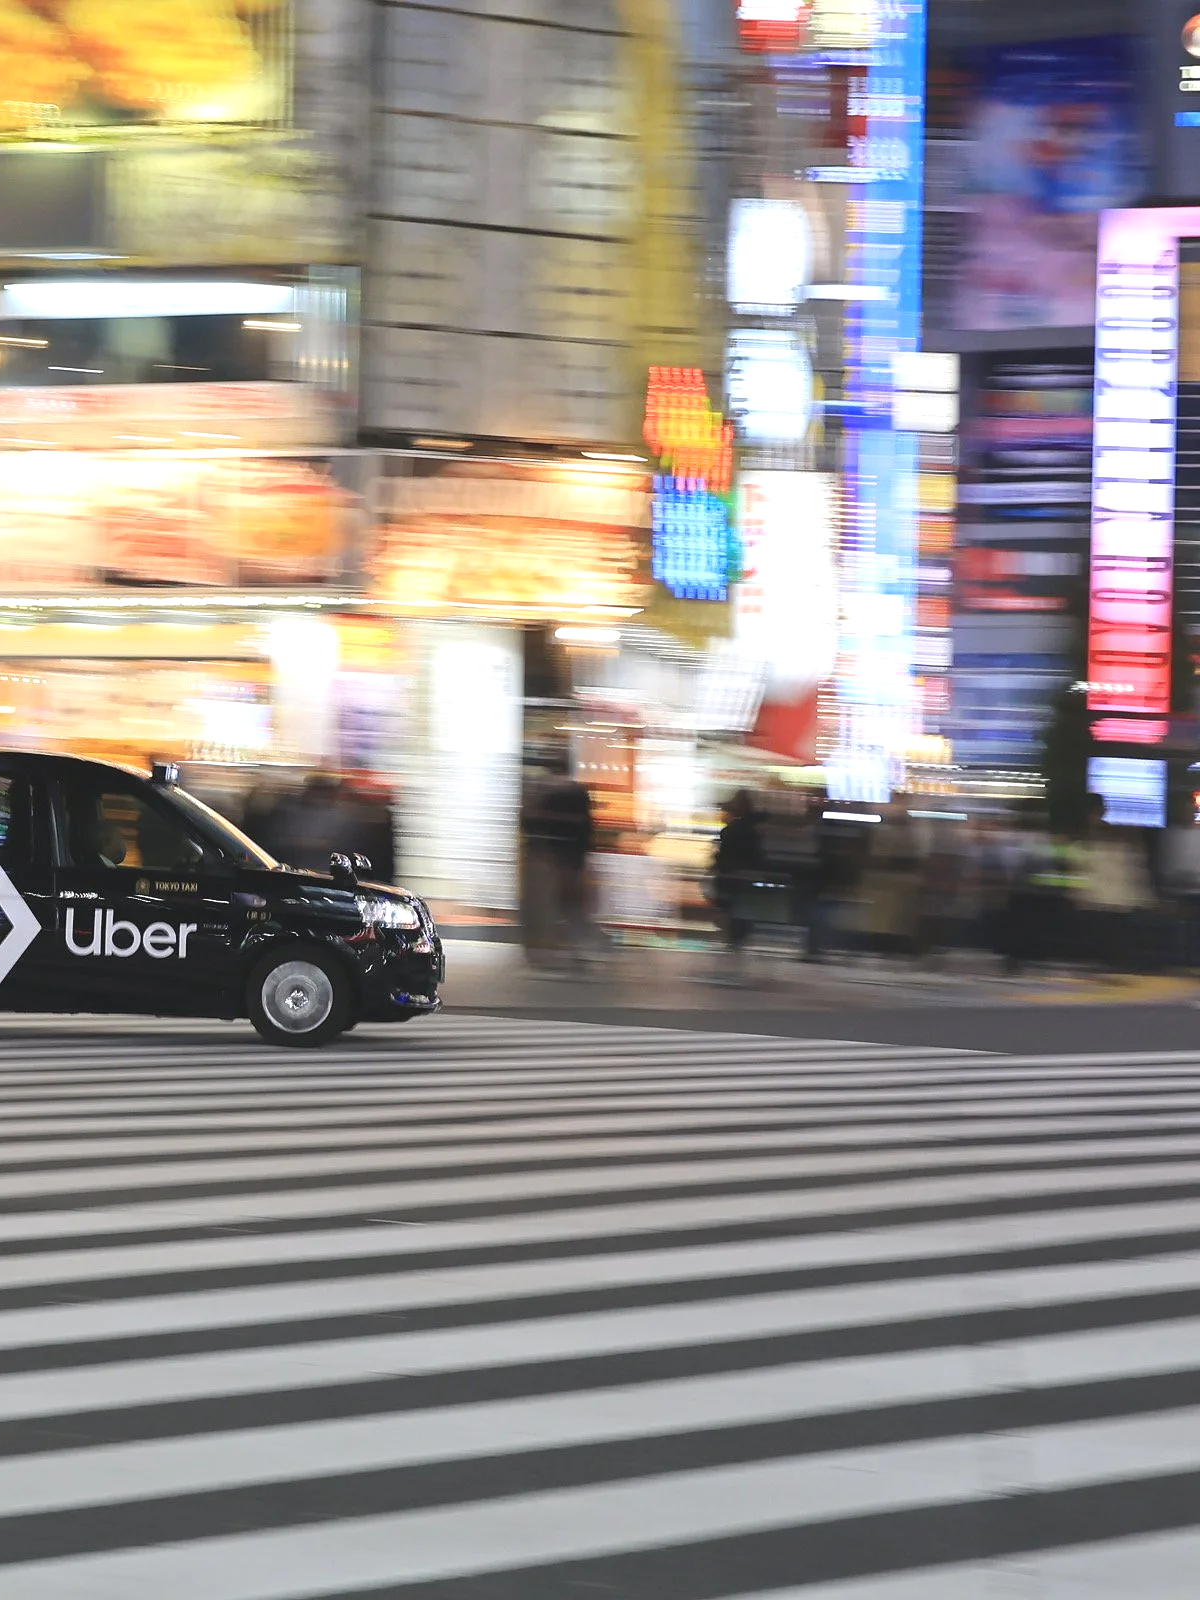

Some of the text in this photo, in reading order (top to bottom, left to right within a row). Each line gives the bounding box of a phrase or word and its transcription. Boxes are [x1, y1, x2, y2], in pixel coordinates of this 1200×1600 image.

[155, 881, 198, 892] TOKYO TAXI
[65, 907, 198, 959] Uber
